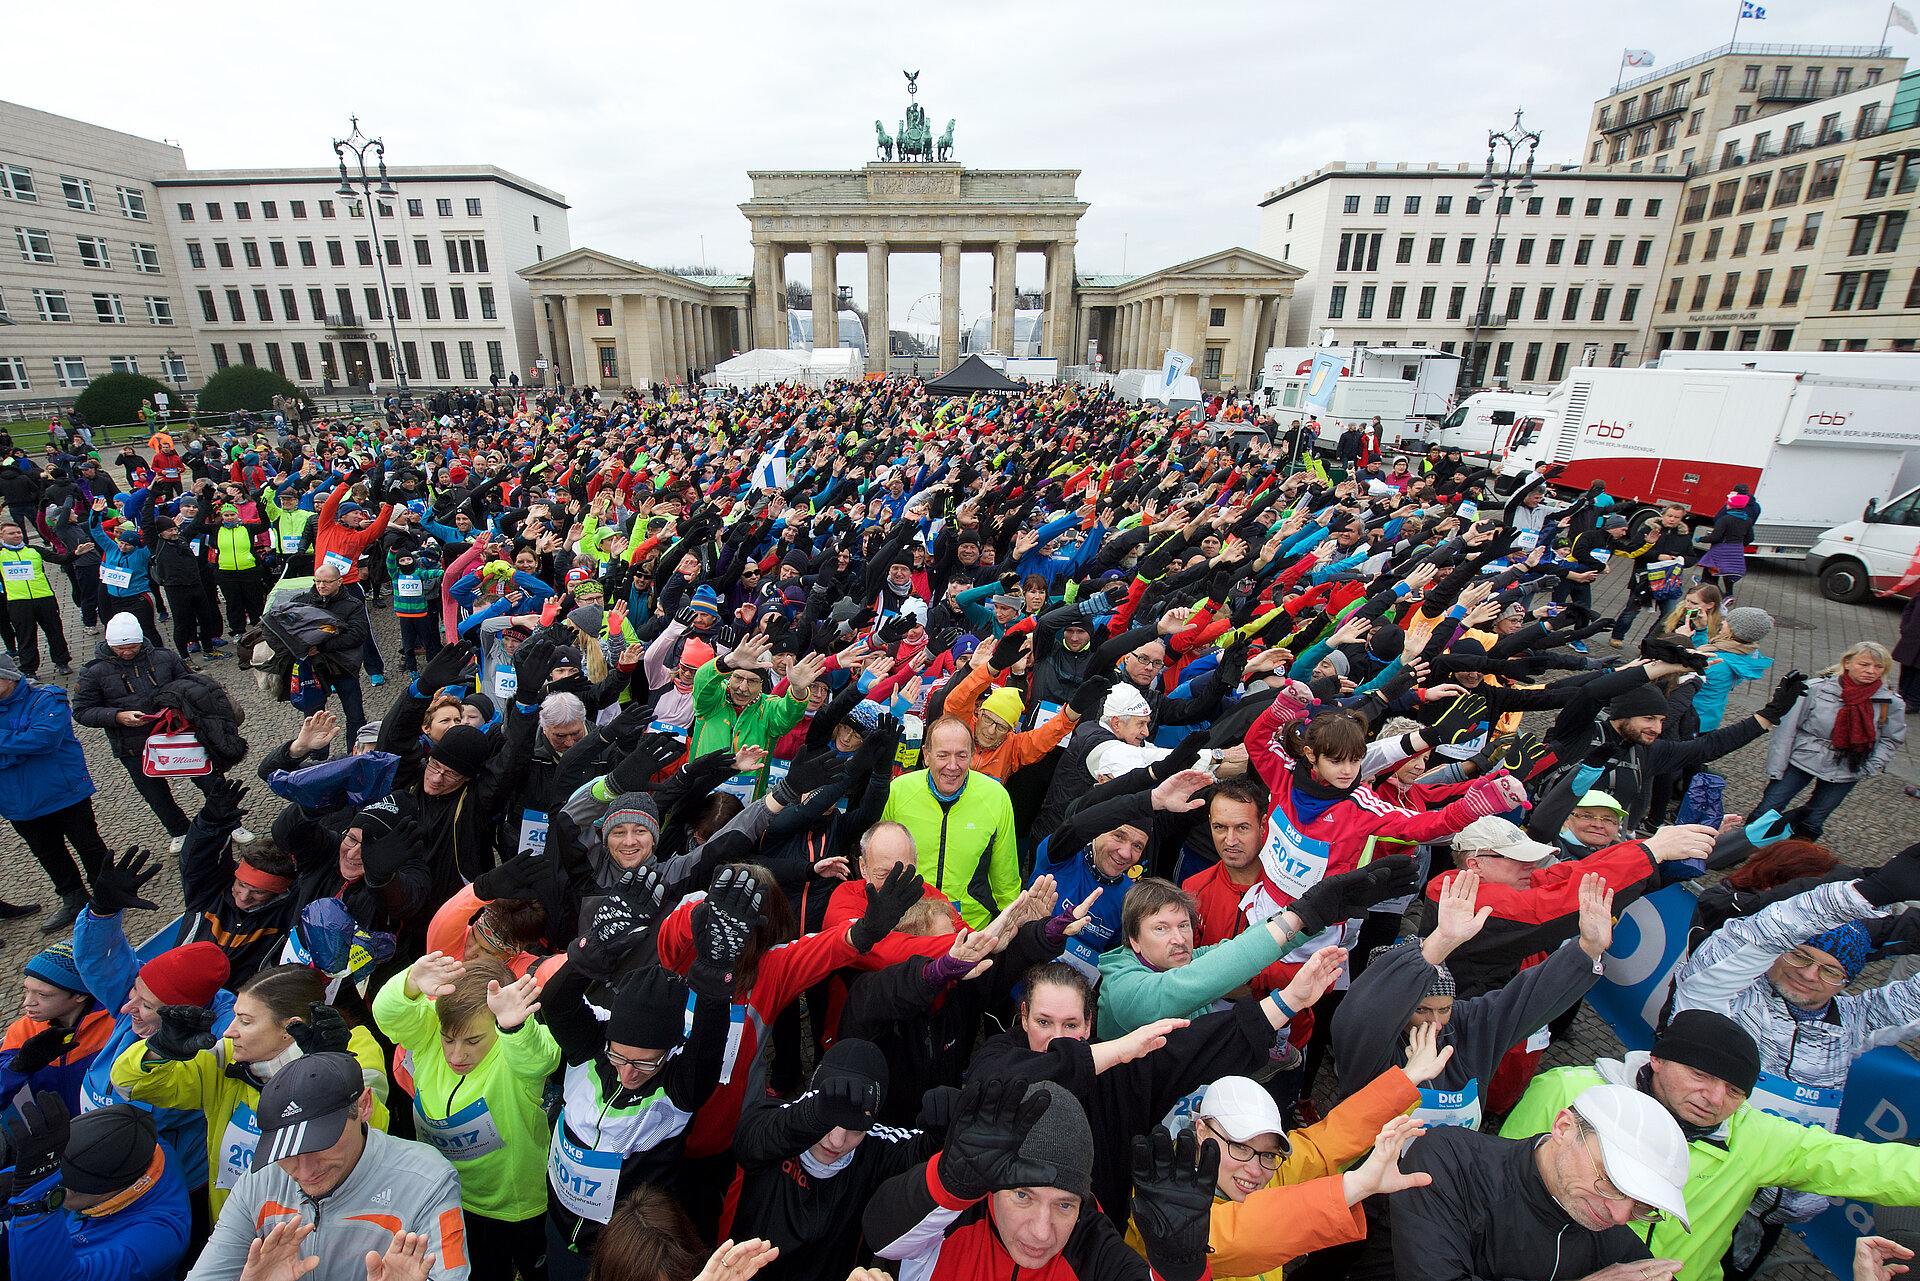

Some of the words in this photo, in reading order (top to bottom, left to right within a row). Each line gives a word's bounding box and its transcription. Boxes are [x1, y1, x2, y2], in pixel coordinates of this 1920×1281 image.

[1807, 411, 1846, 425] rbb
[1586, 420, 1624, 439] rbb
[1843, 430, 1920, 440] BERLIN-BRANDENBUR
[107, 572, 126, 581] 2017
[501, 679, 516, 688] 20
[661, 723, 674, 731] DKB
[172, 755, 202, 764] Miami
[528, 830, 547, 843] 20
[1286, 824, 1302, 843] DKB
[1272, 836, 1312, 878] 2017
[1076, 944, 1092, 957] DKB
[92, 1091, 113, 1105] DKB
[1438, 1093, 1463, 1103] DKB
[1795, 1086, 1819, 1100] DKB
[281, 1107, 303, 1118] adidas
[1174, 1096, 1203, 1115] 20
[425, 1115, 448, 1126] DKB
[421, 1129, 480, 1148] 2017
[563, 1138, 583, 1159] DKB
[229, 1144, 254, 1169] 20
[554, 1147, 602, 1198] 2017
